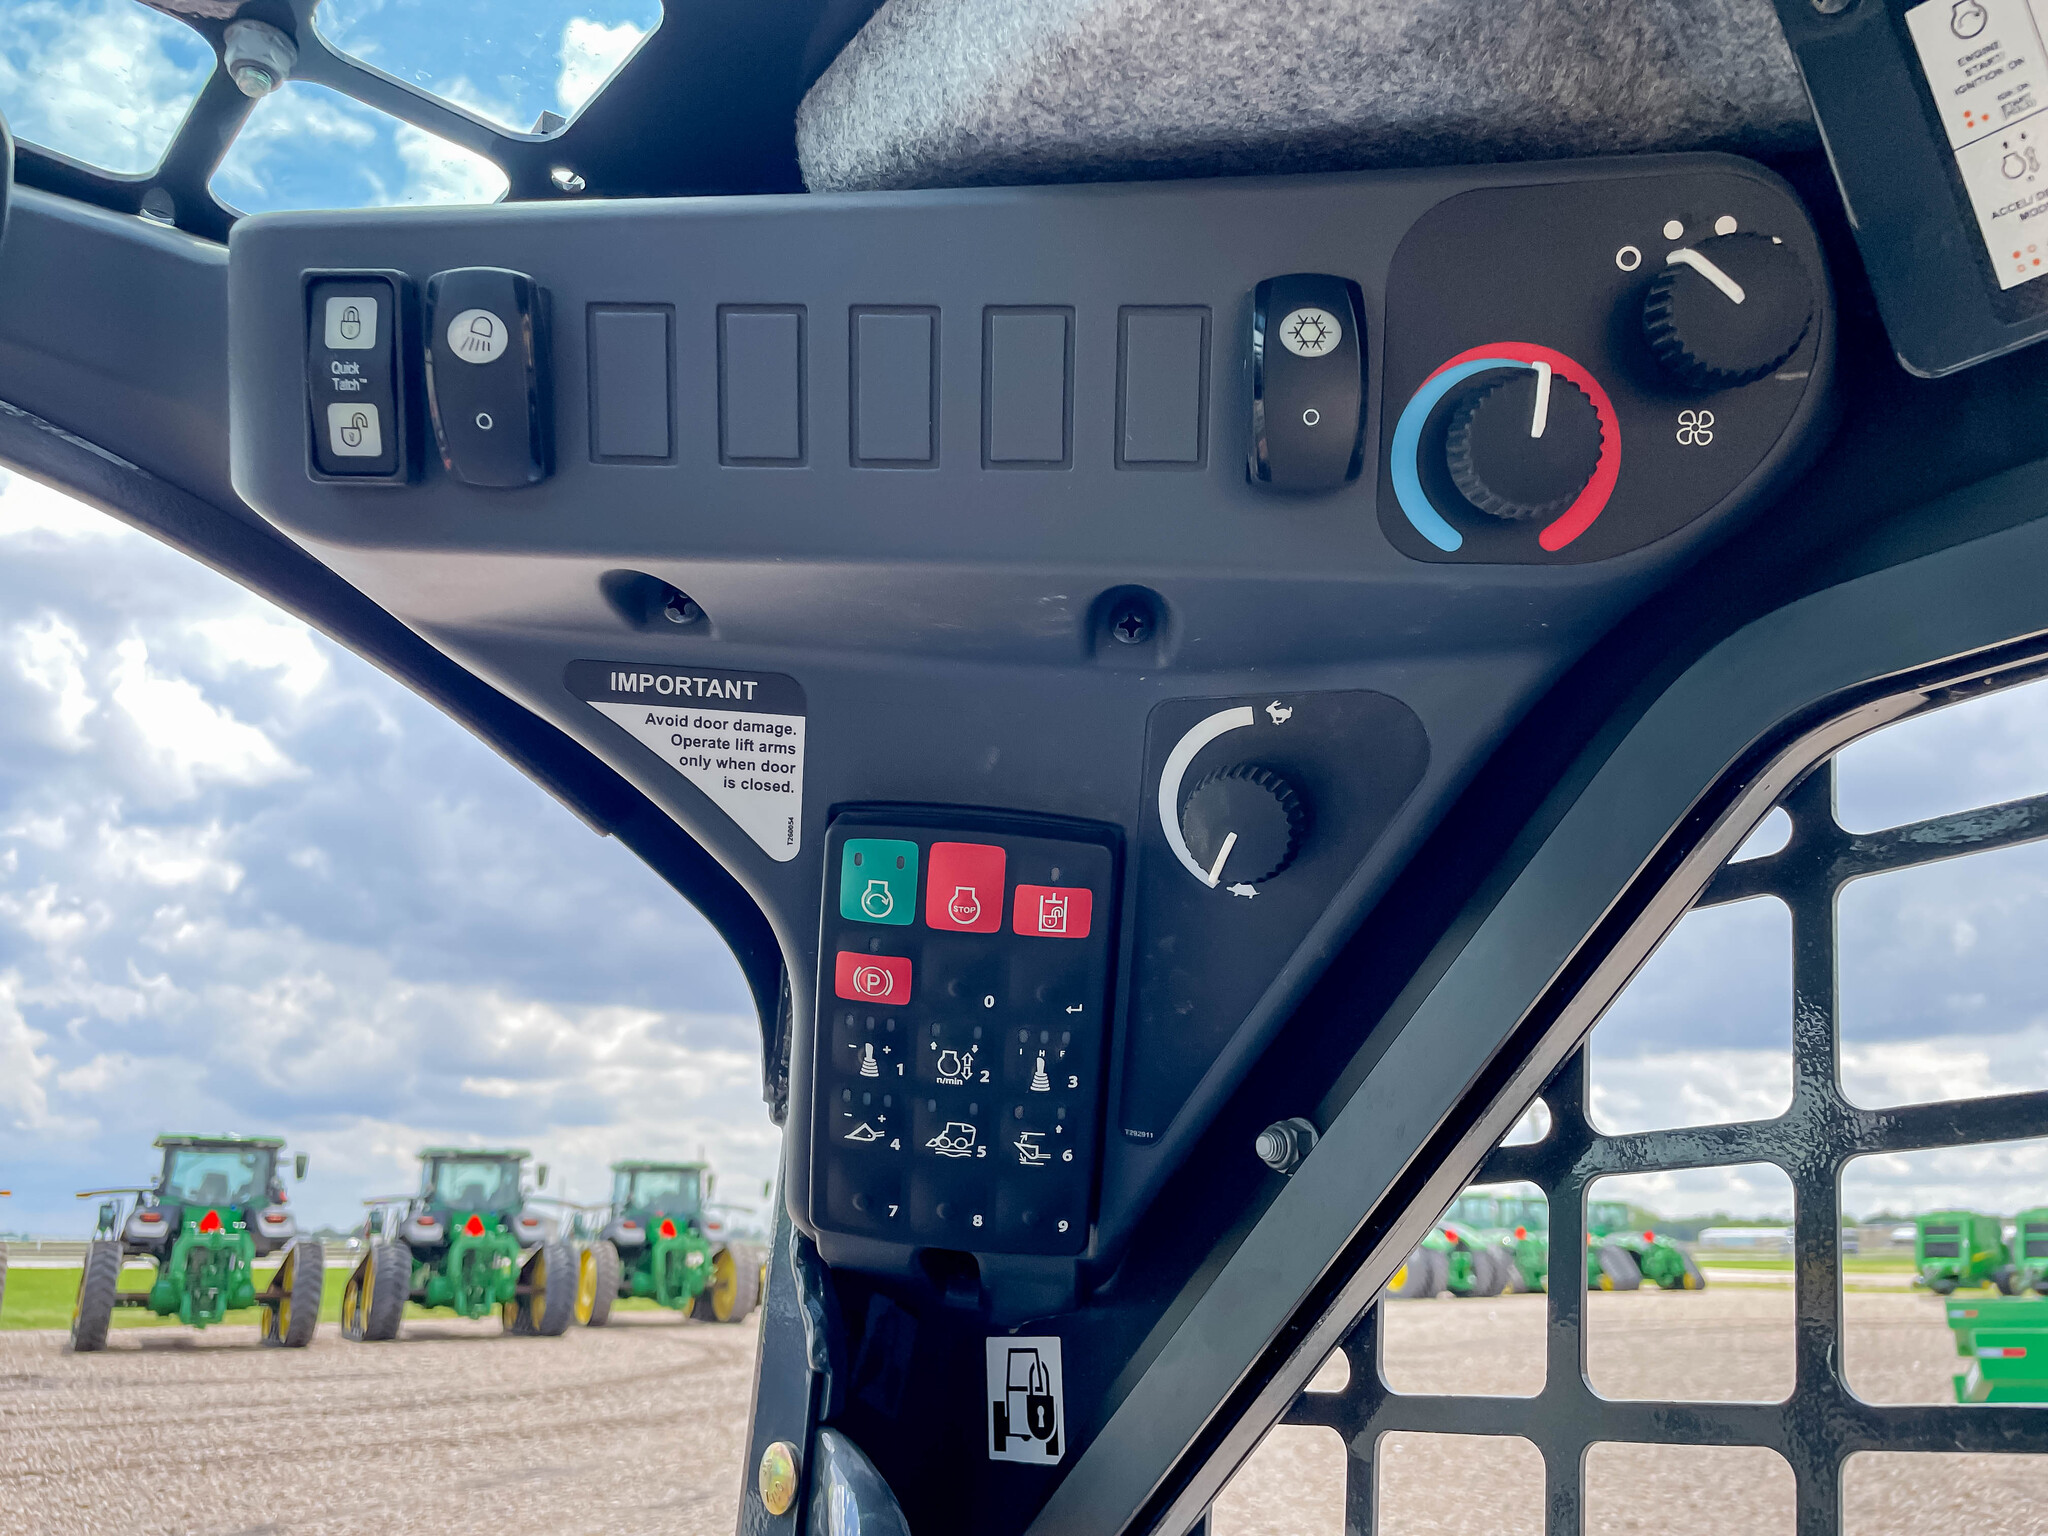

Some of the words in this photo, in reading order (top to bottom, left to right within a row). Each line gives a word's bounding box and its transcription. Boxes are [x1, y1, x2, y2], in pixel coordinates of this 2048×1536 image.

[1954, 68, 2004, 95] IGNITION
[2020, 202, 2048, 221] MOD
[331, 360, 360, 375] Quick
[610, 671, 758, 701] IMPORTANT
[645, 712, 689, 728] Avoid
[693, 716, 729, 731] door
[733, 719, 797, 738] damage.
[671, 733, 730, 750] Operate
[735, 738, 754, 752] lift
[758, 742, 796, 755] arms
[679, 755, 711, 770] only
[716, 757, 756, 771] when
[760, 759, 796, 774] door
[723, 776, 736, 789] is
[740, 777, 795, 793] closed.
[953, 905, 976, 914] STOP
[983, 994, 995, 1009] 0
[896, 1063, 905, 1076] 1
[936, 1076, 964, 1086] n/min
[979, 1070, 990, 1083] 2
[1067, 1075, 1079, 1089] 3
[889, 1138, 901, 1151] 4
[976, 1145, 987, 1158] 5
[1061, 1149, 1073, 1162] 6
[888, 1204, 899, 1217] 7
[972, 1214, 983, 1227] 8
[1057, 1220, 1069, 1233] 9
